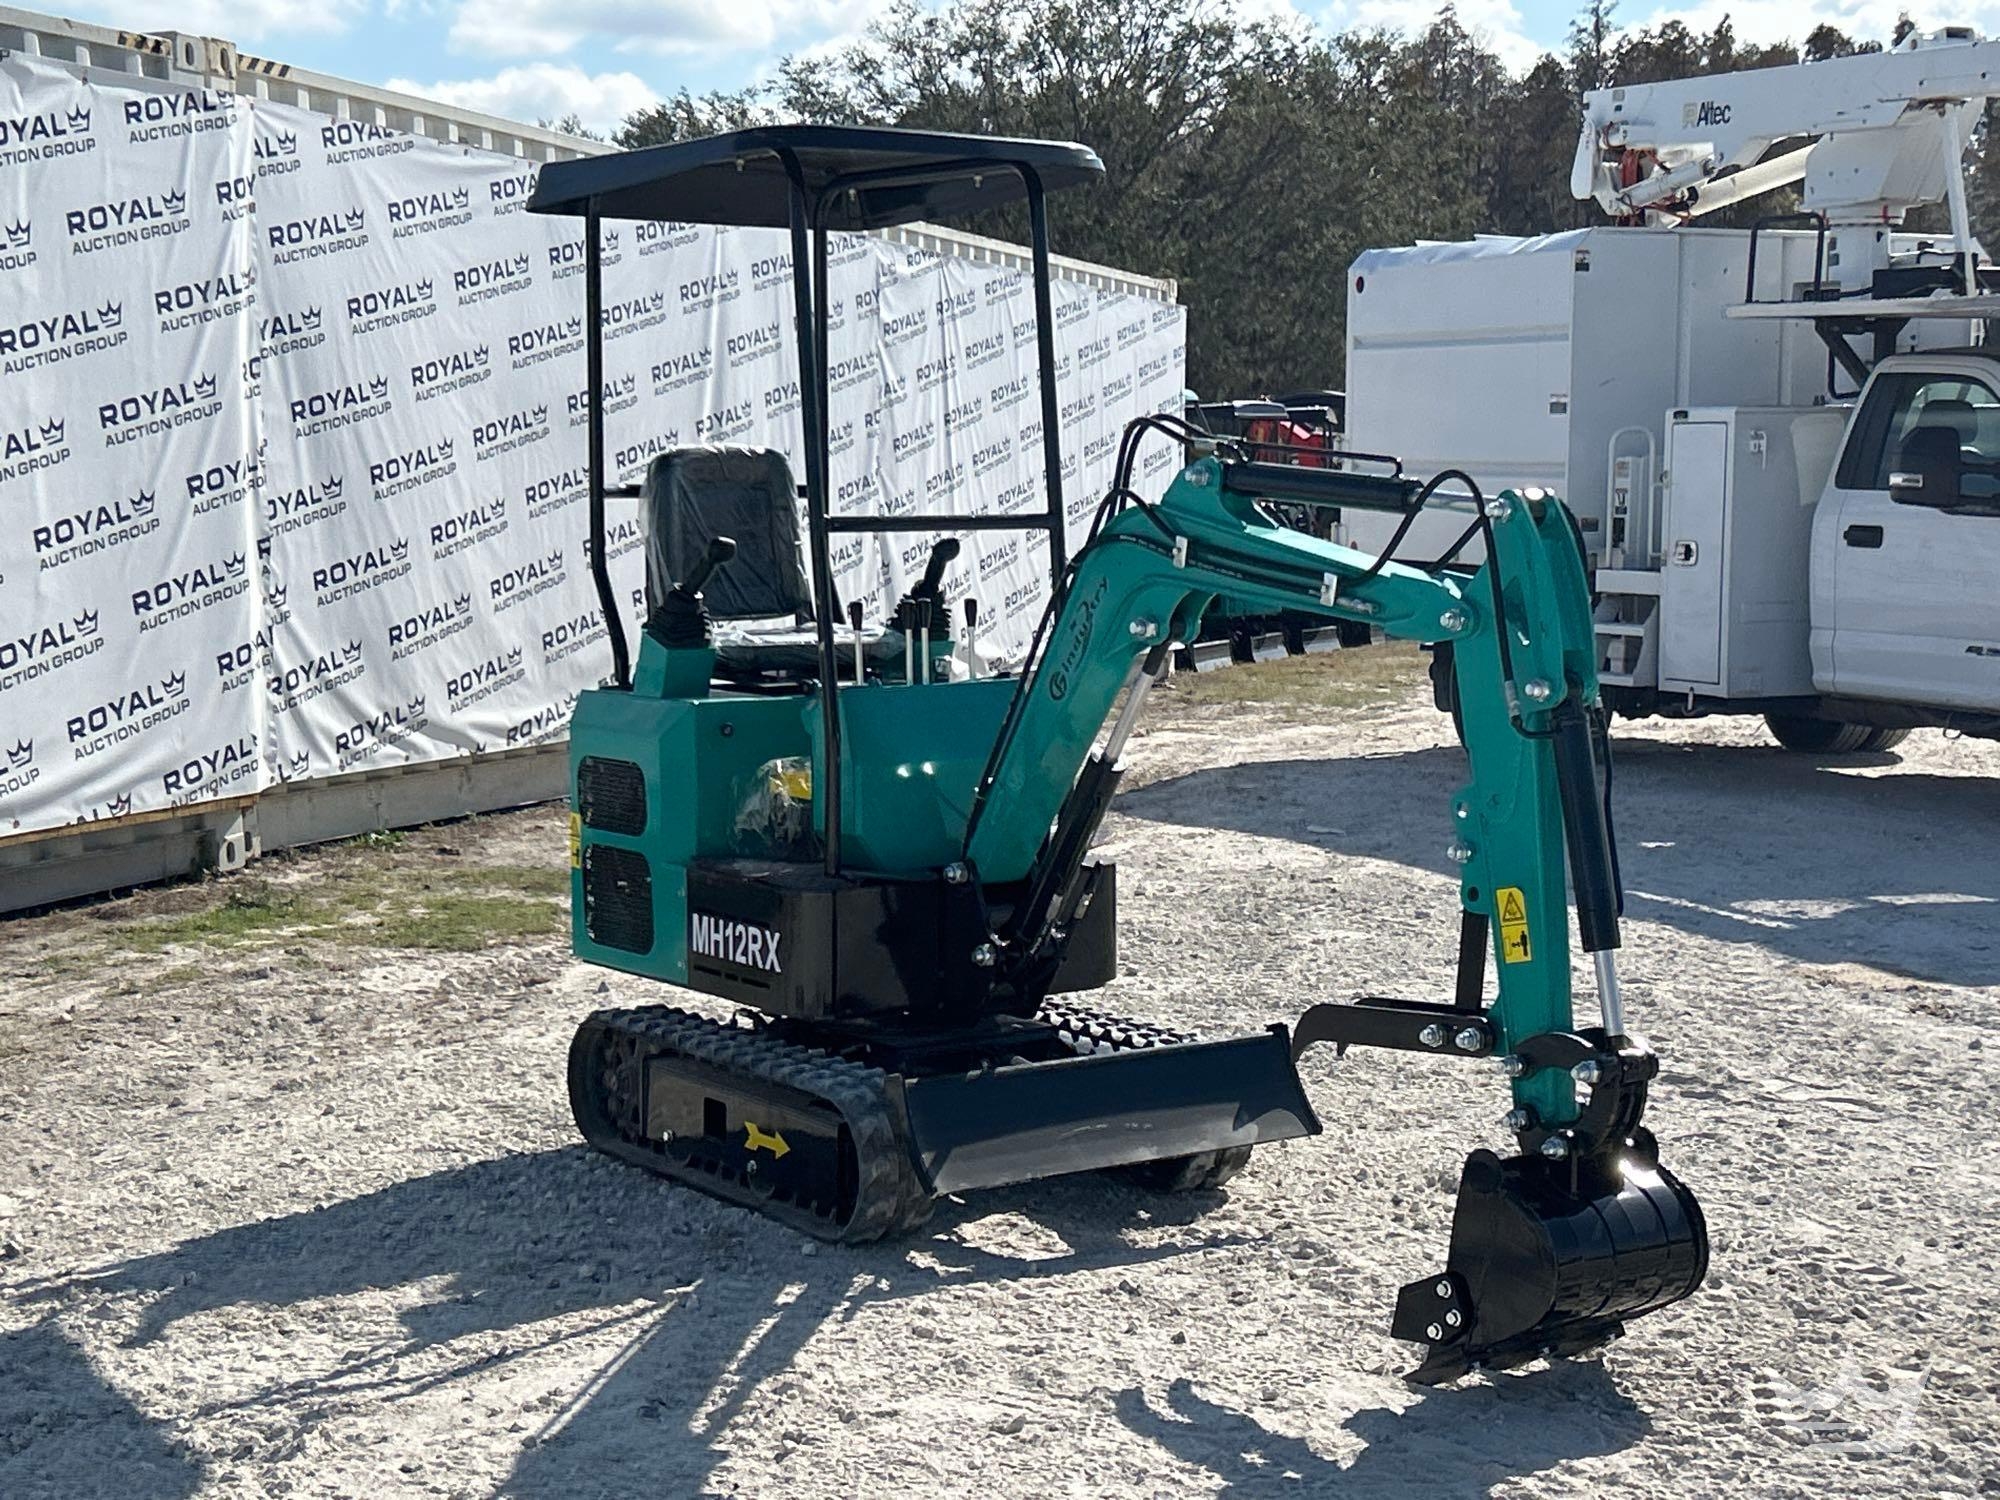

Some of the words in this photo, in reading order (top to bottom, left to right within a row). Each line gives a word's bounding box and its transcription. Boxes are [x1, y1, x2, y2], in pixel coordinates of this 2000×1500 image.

[124, 91, 216, 124] ROYAL
[1696, 101, 1731, 127] Altec
[129, 122, 192, 144] AUCTION
[321, 123, 393, 148] ROYAL
[43, 139, 96, 158] GROUP
[327, 148, 375, 165] AUCTION
[377, 140, 414, 156] GROUP
[258, 159, 301, 177] GROUP
[67, 196, 162, 235] ROYAL
[388, 192, 453, 222] ROYAL
[73, 230, 138, 256] AUCTION
[141, 219, 190, 239] GROUP
[269, 214, 346, 247] ROYAL
[393, 221, 436, 239] AUCTION
[439, 212, 472, 229] GROUP
[636, 221, 686, 243] ROYAL
[274, 244, 326, 265] AUCTION
[329, 235, 369, 253] GROUP
[639, 239, 673, 257] AUCTION
[674, 232, 699, 247] GROUP
[454, 259, 514, 291] ROYAL
[751, 254, 793, 278] ROYAL
[155, 274, 244, 315] ROYAL
[458, 287, 499, 307] AUCTION
[500, 277, 532, 295] GROUP
[680, 274, 727, 302] ROYAL
[754, 276, 783, 292] AUCTION
[985, 276, 1014, 296] ROYAL
[347, 284, 417, 318] ROYAL
[601, 297, 651, 326] ROYAL
[683, 299, 714, 315] AUCTION
[1056, 303, 1082, 320] ROYAL
[0, 311, 98, 354] ROYAL
[161, 308, 221, 333] AUCTION
[352, 312, 400, 335] AUCTION
[402, 304, 436, 322] GROUP
[604, 320, 638, 341] AUCTION
[639, 314, 666, 331] GROUP
[884, 315, 919, 336] ROYAL
[1117, 323, 1140, 341] ROYAL
[5, 344, 71, 375] AUCTION
[75, 331, 128, 356] GROUP
[281, 333, 325, 354] GROUP
[508, 322, 568, 356] ROYAL
[727, 328, 769, 355] ROYAL
[966, 338, 998, 360] ROYAL
[1078, 340, 1104, 361] ROYAL
[412, 352, 474, 386] ROYAL
[512, 350, 552, 370] AUCTION
[554, 340, 584, 356] GROUP
[652, 352, 700, 383] ROYAL
[731, 350, 758, 368] AUCTION
[759, 342, 782, 357] GROUP
[830, 358, 867, 381] ROYAL
[917, 358, 948, 382] ROYAL
[1139, 358, 1162, 379] ROYAL
[416, 378, 457, 402] AUCTION
[459, 369, 491, 388] GROUP
[655, 376, 687, 396] AUCTION
[991, 381, 1021, 403] ROYAL
[1103, 378, 1127, 398] ROYAL
[100, 383, 195, 429] ROYAL
[291, 384, 370, 422] ROYAL
[610, 395, 637, 415] GROUP
[767, 404, 793, 420] AUCTION
[944, 403, 974, 427] ROYAL
[1062, 398, 1088, 420] ROYAL
[106, 418, 172, 447] AUCTION
[175, 401, 222, 426] GROUP
[296, 414, 350, 439] AUCTION
[353, 401, 392, 422] GROUP
[473, 412, 533, 447] ROYAL
[696, 406, 742, 436] ROYAL
[731, 419, 754, 435] GROUP
[477, 439, 516, 462] AUCTION
[518, 428, 550, 445] GROUP
[616, 437, 667, 469] ROYAL
[893, 428, 927, 452] ROYAL
[972, 444, 1004, 465] ROYAL
[1084, 436, 1110, 458] ROYAL
[18, 448, 70, 475] GROUP
[371, 446, 439, 485] ROYAL
[1143, 450, 1166, 470] ROYAL
[375, 475, 422, 501] AUCTION
[423, 462, 456, 483] GROUP
[526, 469, 583, 505] ROYAL
[927, 469, 957, 492] ROYAL
[998, 484, 1028, 507] ROYAL
[305, 502, 347, 525] GROUP
[529, 496, 567, 520] AUCTION
[1067, 494, 1094, 517] ROYAL
[34, 501, 131, 552] ROYAL
[431, 506, 490, 546] ROYAL
[434, 536, 475, 561] AUCTION
[476, 520, 508, 541] GROUP
[40, 542, 105, 572] AUCTION
[108, 518, 160, 545] GROUP
[979, 546, 1010, 571] ROYAL
[314, 548, 391, 591] ROYAL
[490, 559, 549, 599] ROYAL
[132, 565, 225, 615] ROYAL
[317, 578, 371, 608] AUCTION
[373, 563, 412, 586] GROUP
[494, 587, 533, 614] AUCTION
[534, 573, 566, 593] GROUP
[1004, 584, 1035, 608] ROYAL
[140, 598, 200, 633] AUCTION
[203, 579, 250, 606] GROUP
[389, 602, 455, 646] ROYAL
[392, 631, 439, 662] AUCTION
[440, 616, 474, 639] GROUP
[542, 610, 599, 650] ROYAL
[52, 637, 104, 668] GROUP
[545, 639, 585, 664] AUCTION
[270, 651, 344, 696] ROYAL
[447, 656, 508, 700] ROYAL
[272, 684, 323, 714] AUCTION
[326, 665, 365, 691] GROUP
[451, 685, 492, 715] AUCTION
[493, 669, 525, 692] GROUP
[67, 685, 163, 742] ROYAL
[507, 702, 566, 746] ROYAL
[75, 722, 139, 761] AUCTION
[142, 699, 190, 729] GROUP
[336, 707, 407, 753] ROYAL
[339, 738, 387, 771] AUCTION
[389, 719, 429, 746] GROUP
[164, 738, 253, 794] ROYAL
[692, 912, 782, 973] MH12RX
